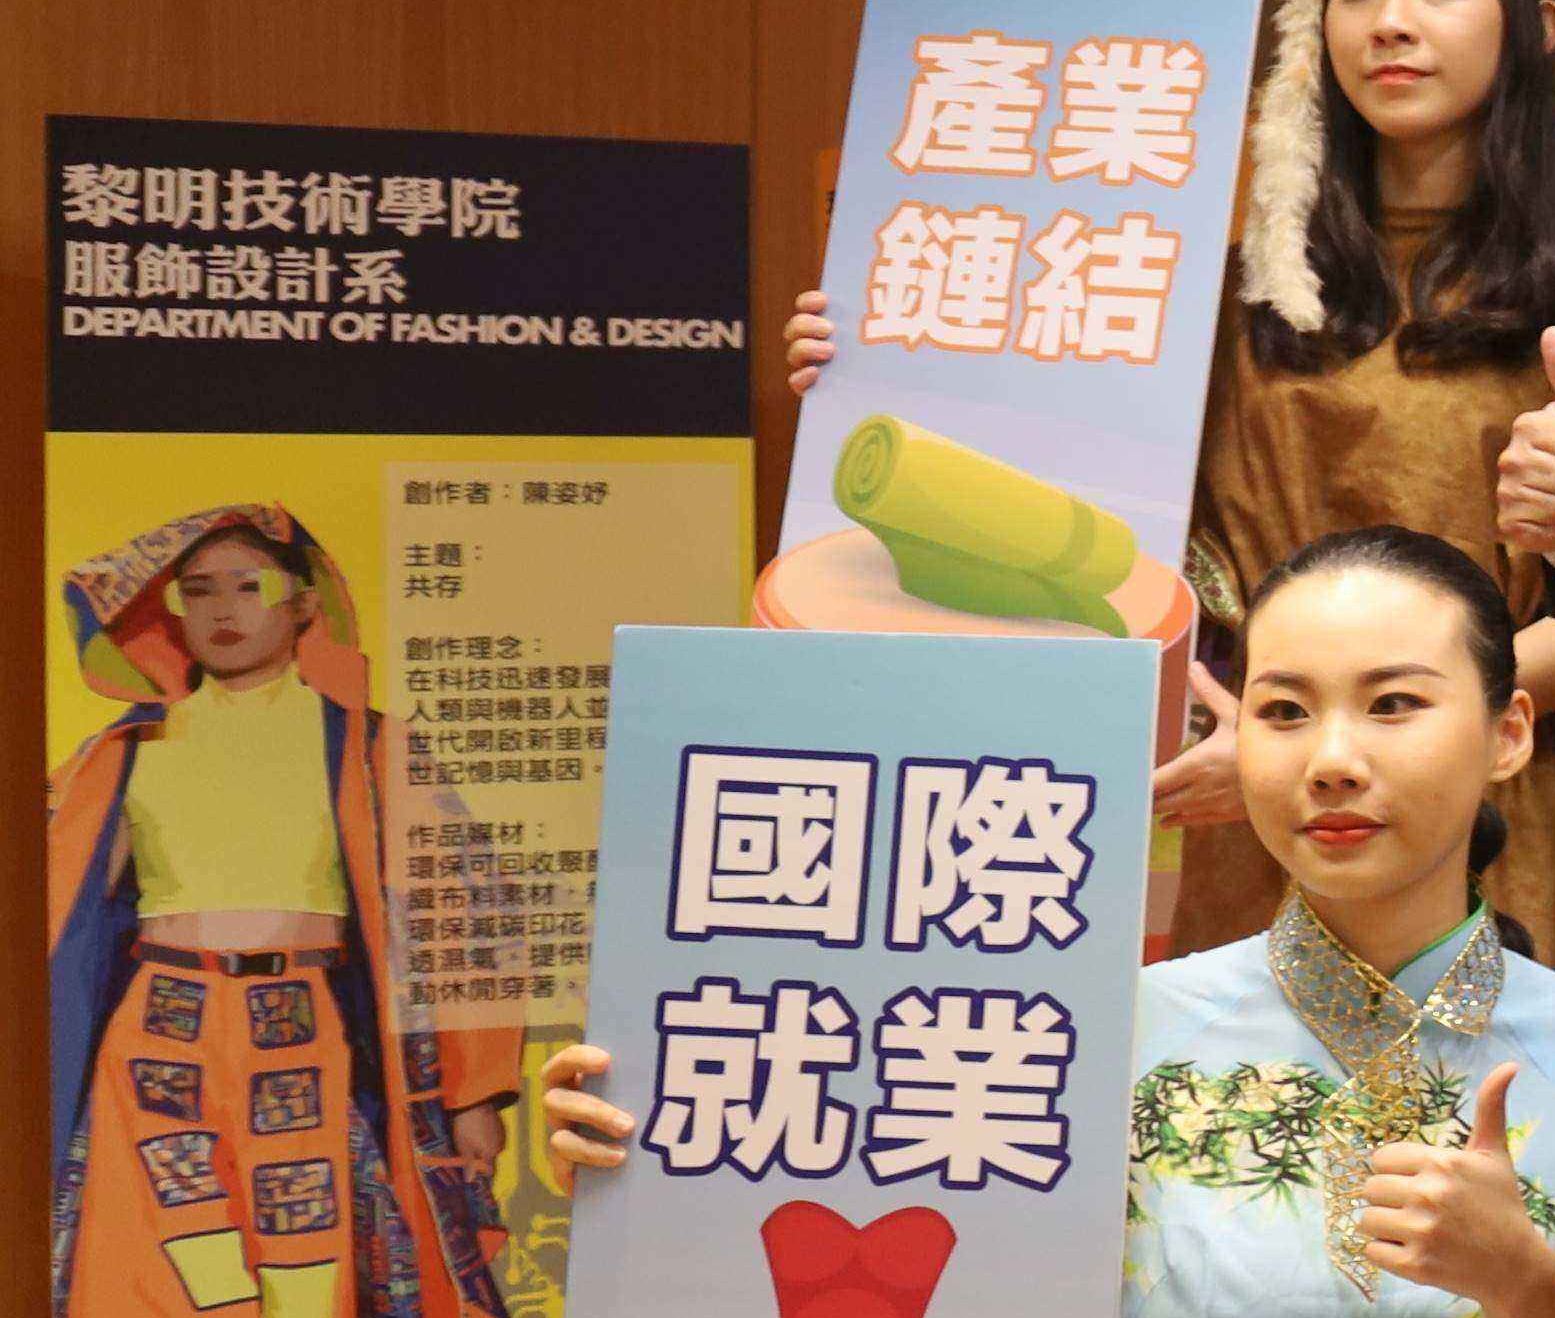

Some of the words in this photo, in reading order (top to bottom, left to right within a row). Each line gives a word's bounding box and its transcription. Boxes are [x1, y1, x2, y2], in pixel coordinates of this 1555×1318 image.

[888, 30, 1206, 187] 產業
[62, 163, 522, 239] 黎明技術學院
[63, 240, 407, 305] 服飾設計系
[63, 308, 324, 340] DEPARTMENT
[331, 311, 387, 342] OF
[392, 312, 562, 345] FASHION
[569, 316, 602, 347] &
[608, 317, 744, 350] DESIGN
[859, 203, 1181, 365] 鏈結
[405, 574, 463, 599] 共存
[667, 744, 1097, 953] 國際
[641, 977, 1077, 1192] 就業
